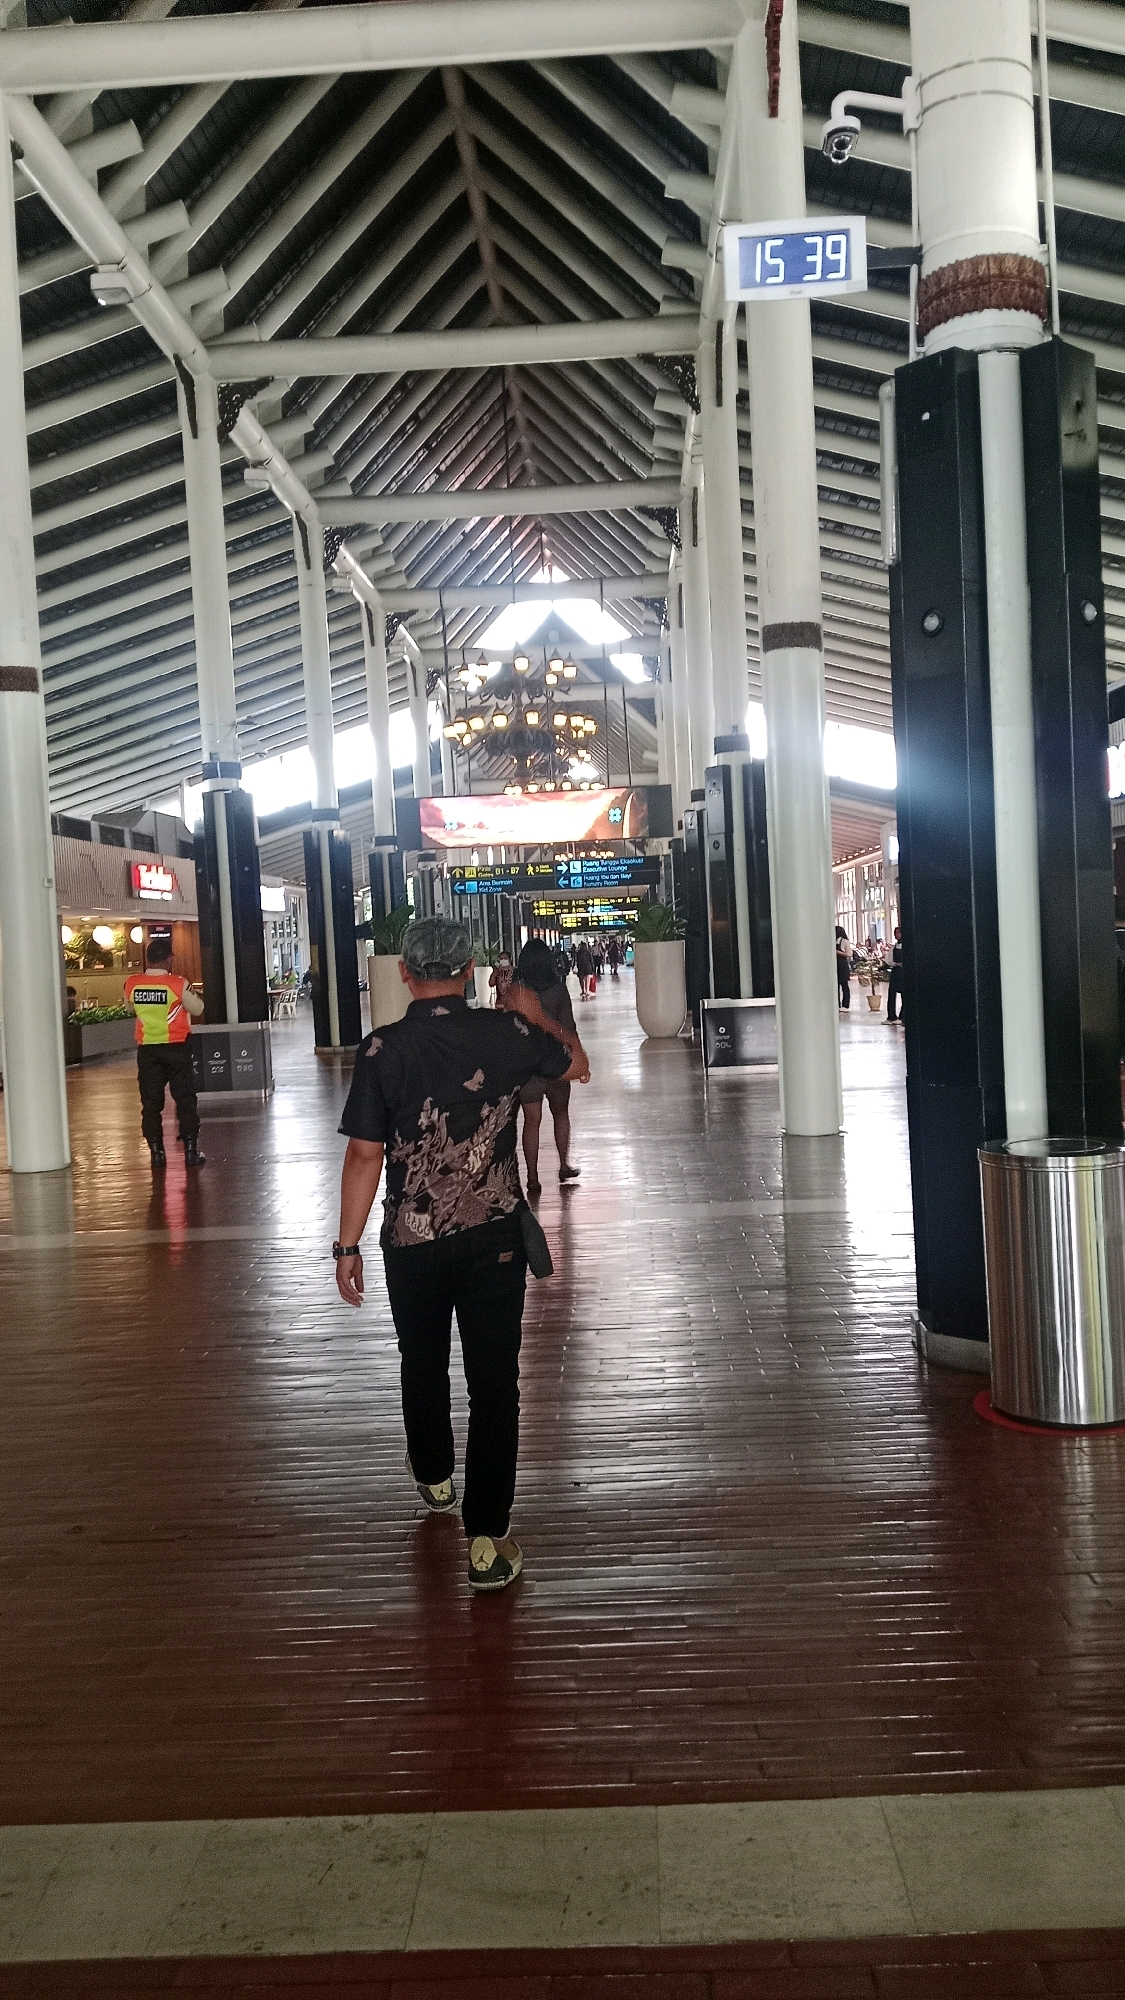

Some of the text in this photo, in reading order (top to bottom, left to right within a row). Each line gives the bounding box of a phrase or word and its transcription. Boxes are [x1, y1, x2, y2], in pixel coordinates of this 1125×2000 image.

[756, 234, 846, 283] 15 39
[510, 866, 520, 874] B7
[134, 991, 167, 1002] SECURITY
